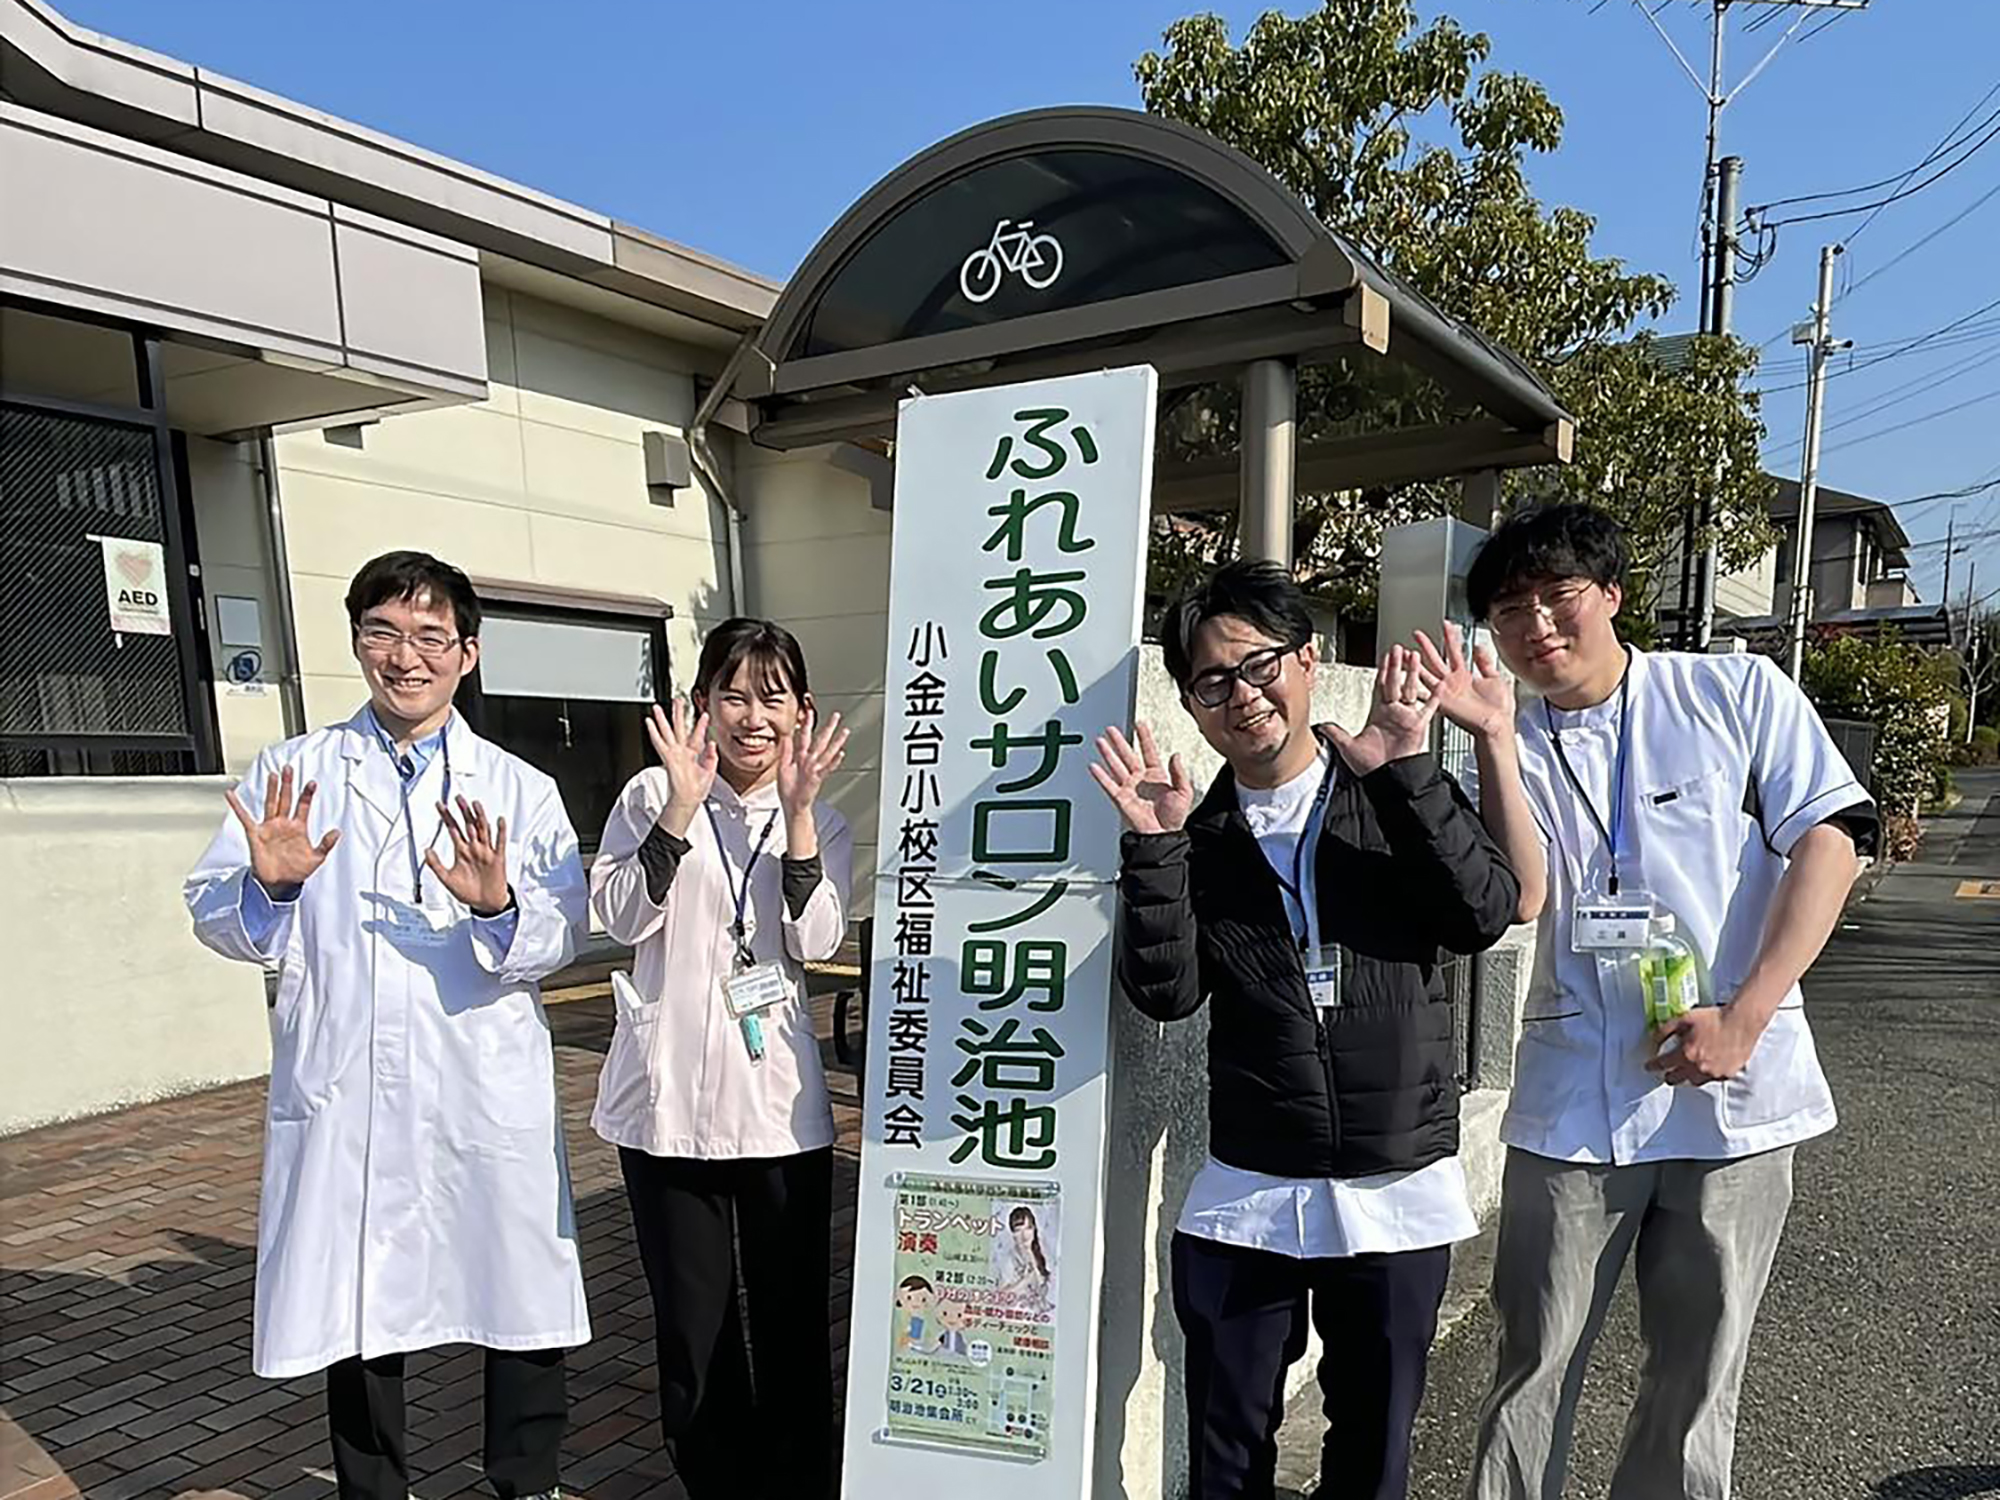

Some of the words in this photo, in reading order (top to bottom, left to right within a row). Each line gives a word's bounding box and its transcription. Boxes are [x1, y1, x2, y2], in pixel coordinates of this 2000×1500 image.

[118, 589, 158, 606] AED
[951, 407, 1098, 1170] ふれあいサロン明治池
[884, 619, 948, 1149] 小金台小校区福祉委員会
[899, 1206, 1005, 1237] トランペット
[897, 1231, 938, 1255] 演奏
